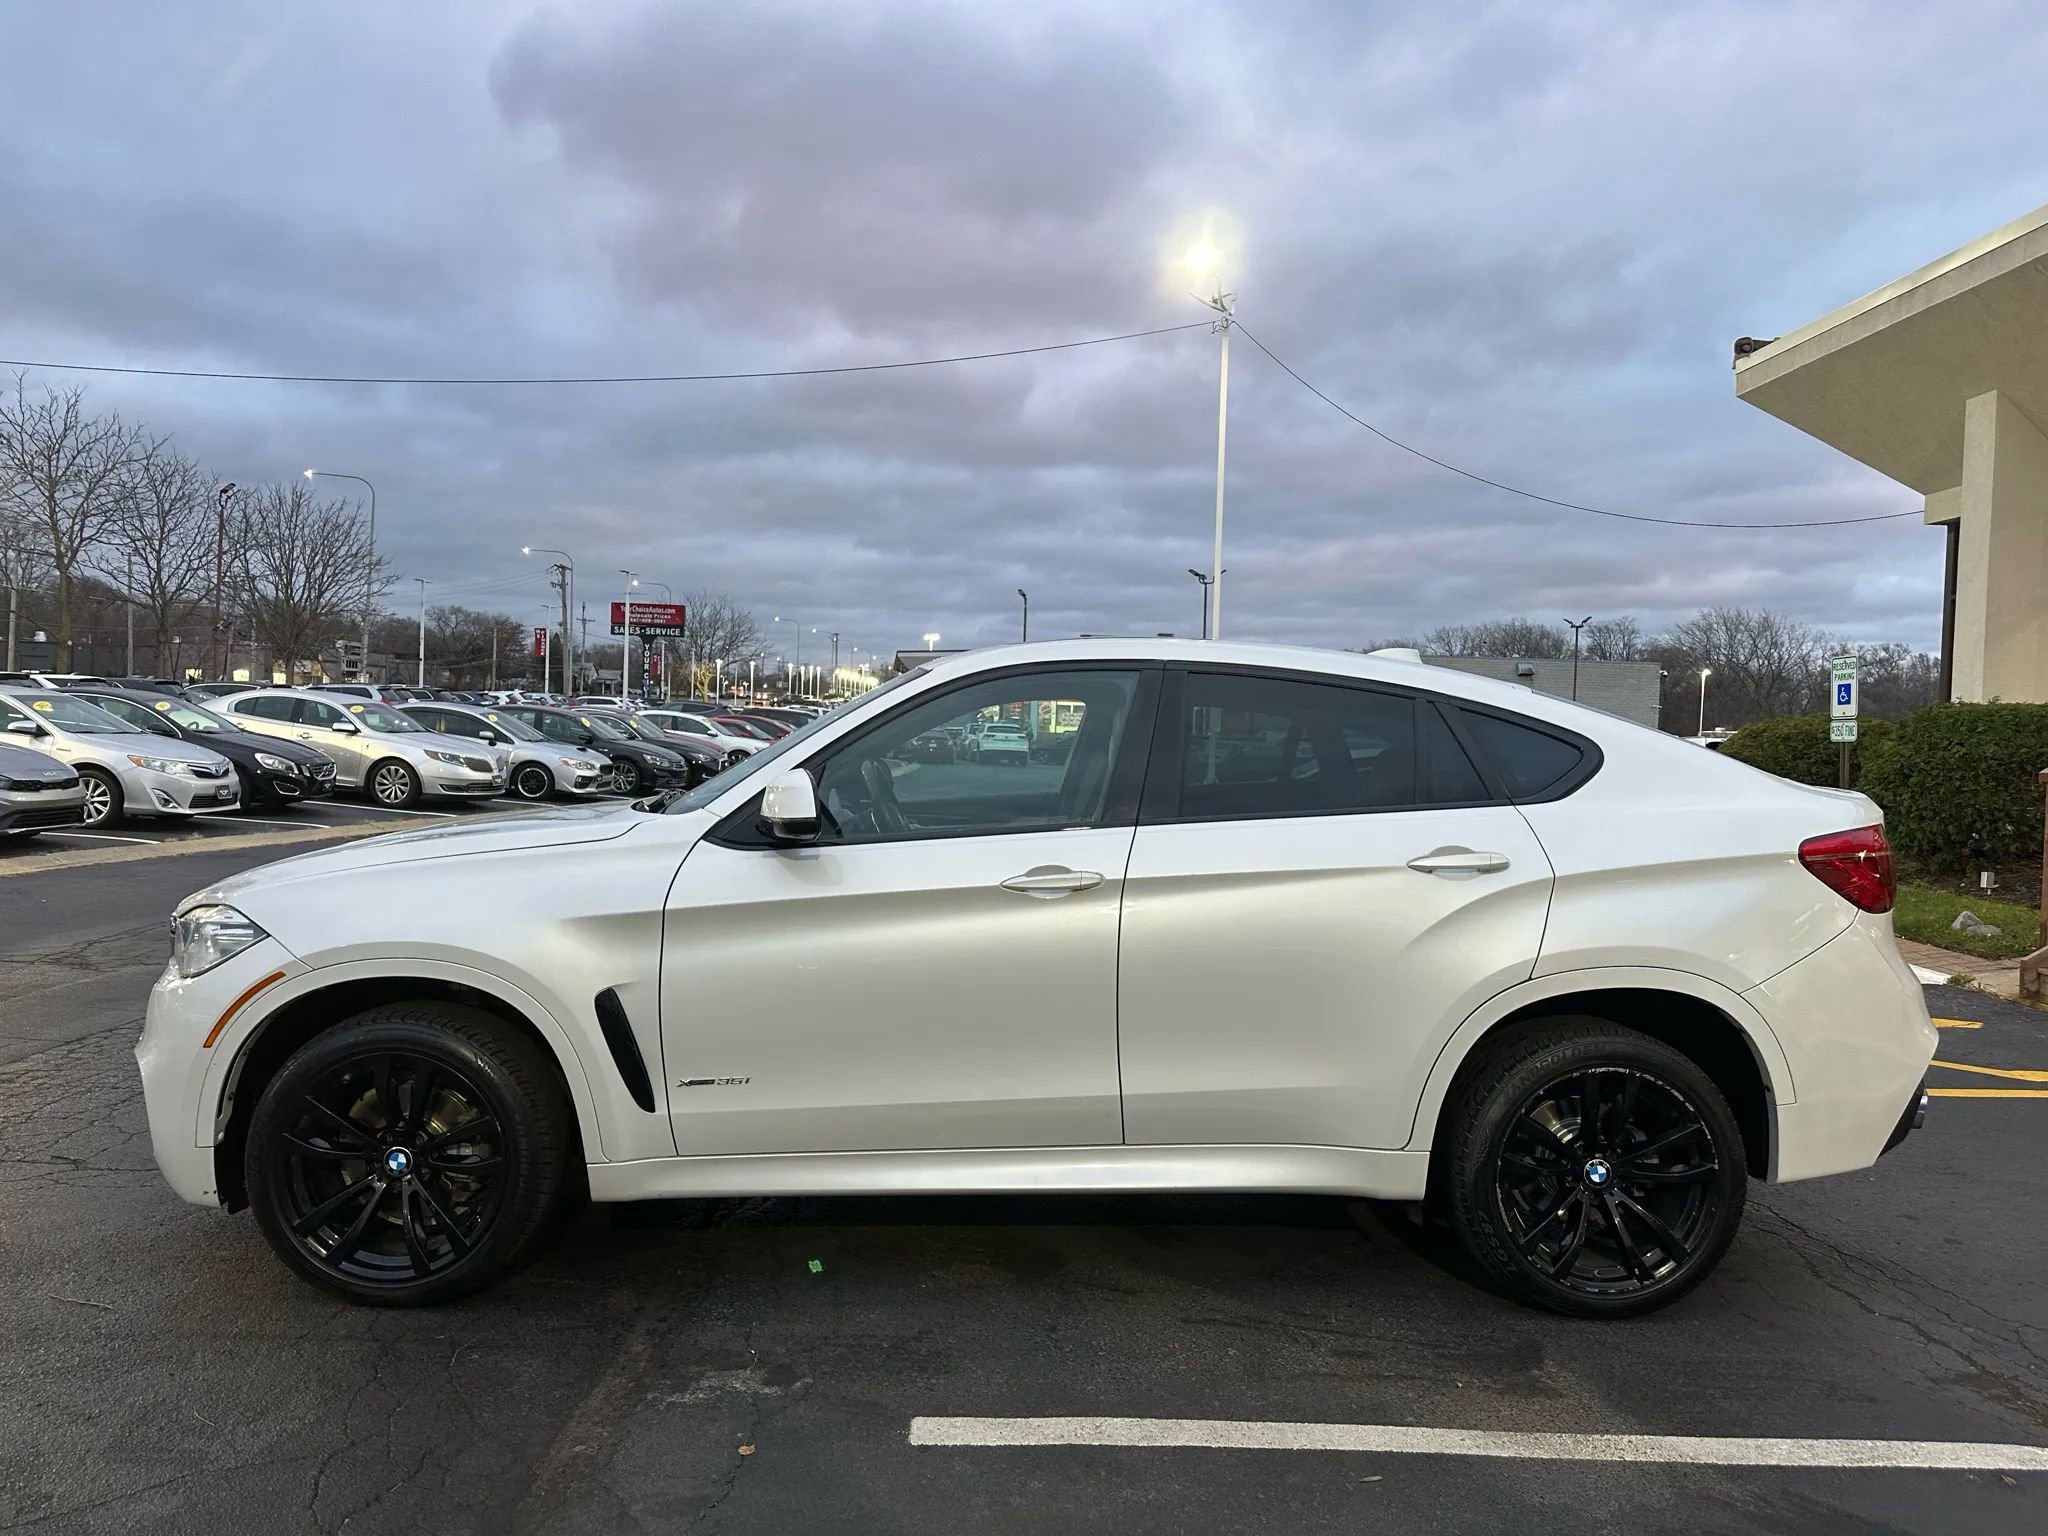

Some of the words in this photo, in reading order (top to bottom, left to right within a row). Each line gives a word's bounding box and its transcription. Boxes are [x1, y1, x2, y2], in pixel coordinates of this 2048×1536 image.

[620, 605, 676, 614] YorChoiceAutos.com
[614, 626, 641, 635] SAES
[645, 627, 681, 636] SERVICE
[1833, 662, 1857, 671] RESERVED
[1834, 672, 1855, 681] PARKING
[1831, 725, 1844, 737] $350
[1845, 725, 1856, 737] FINE
